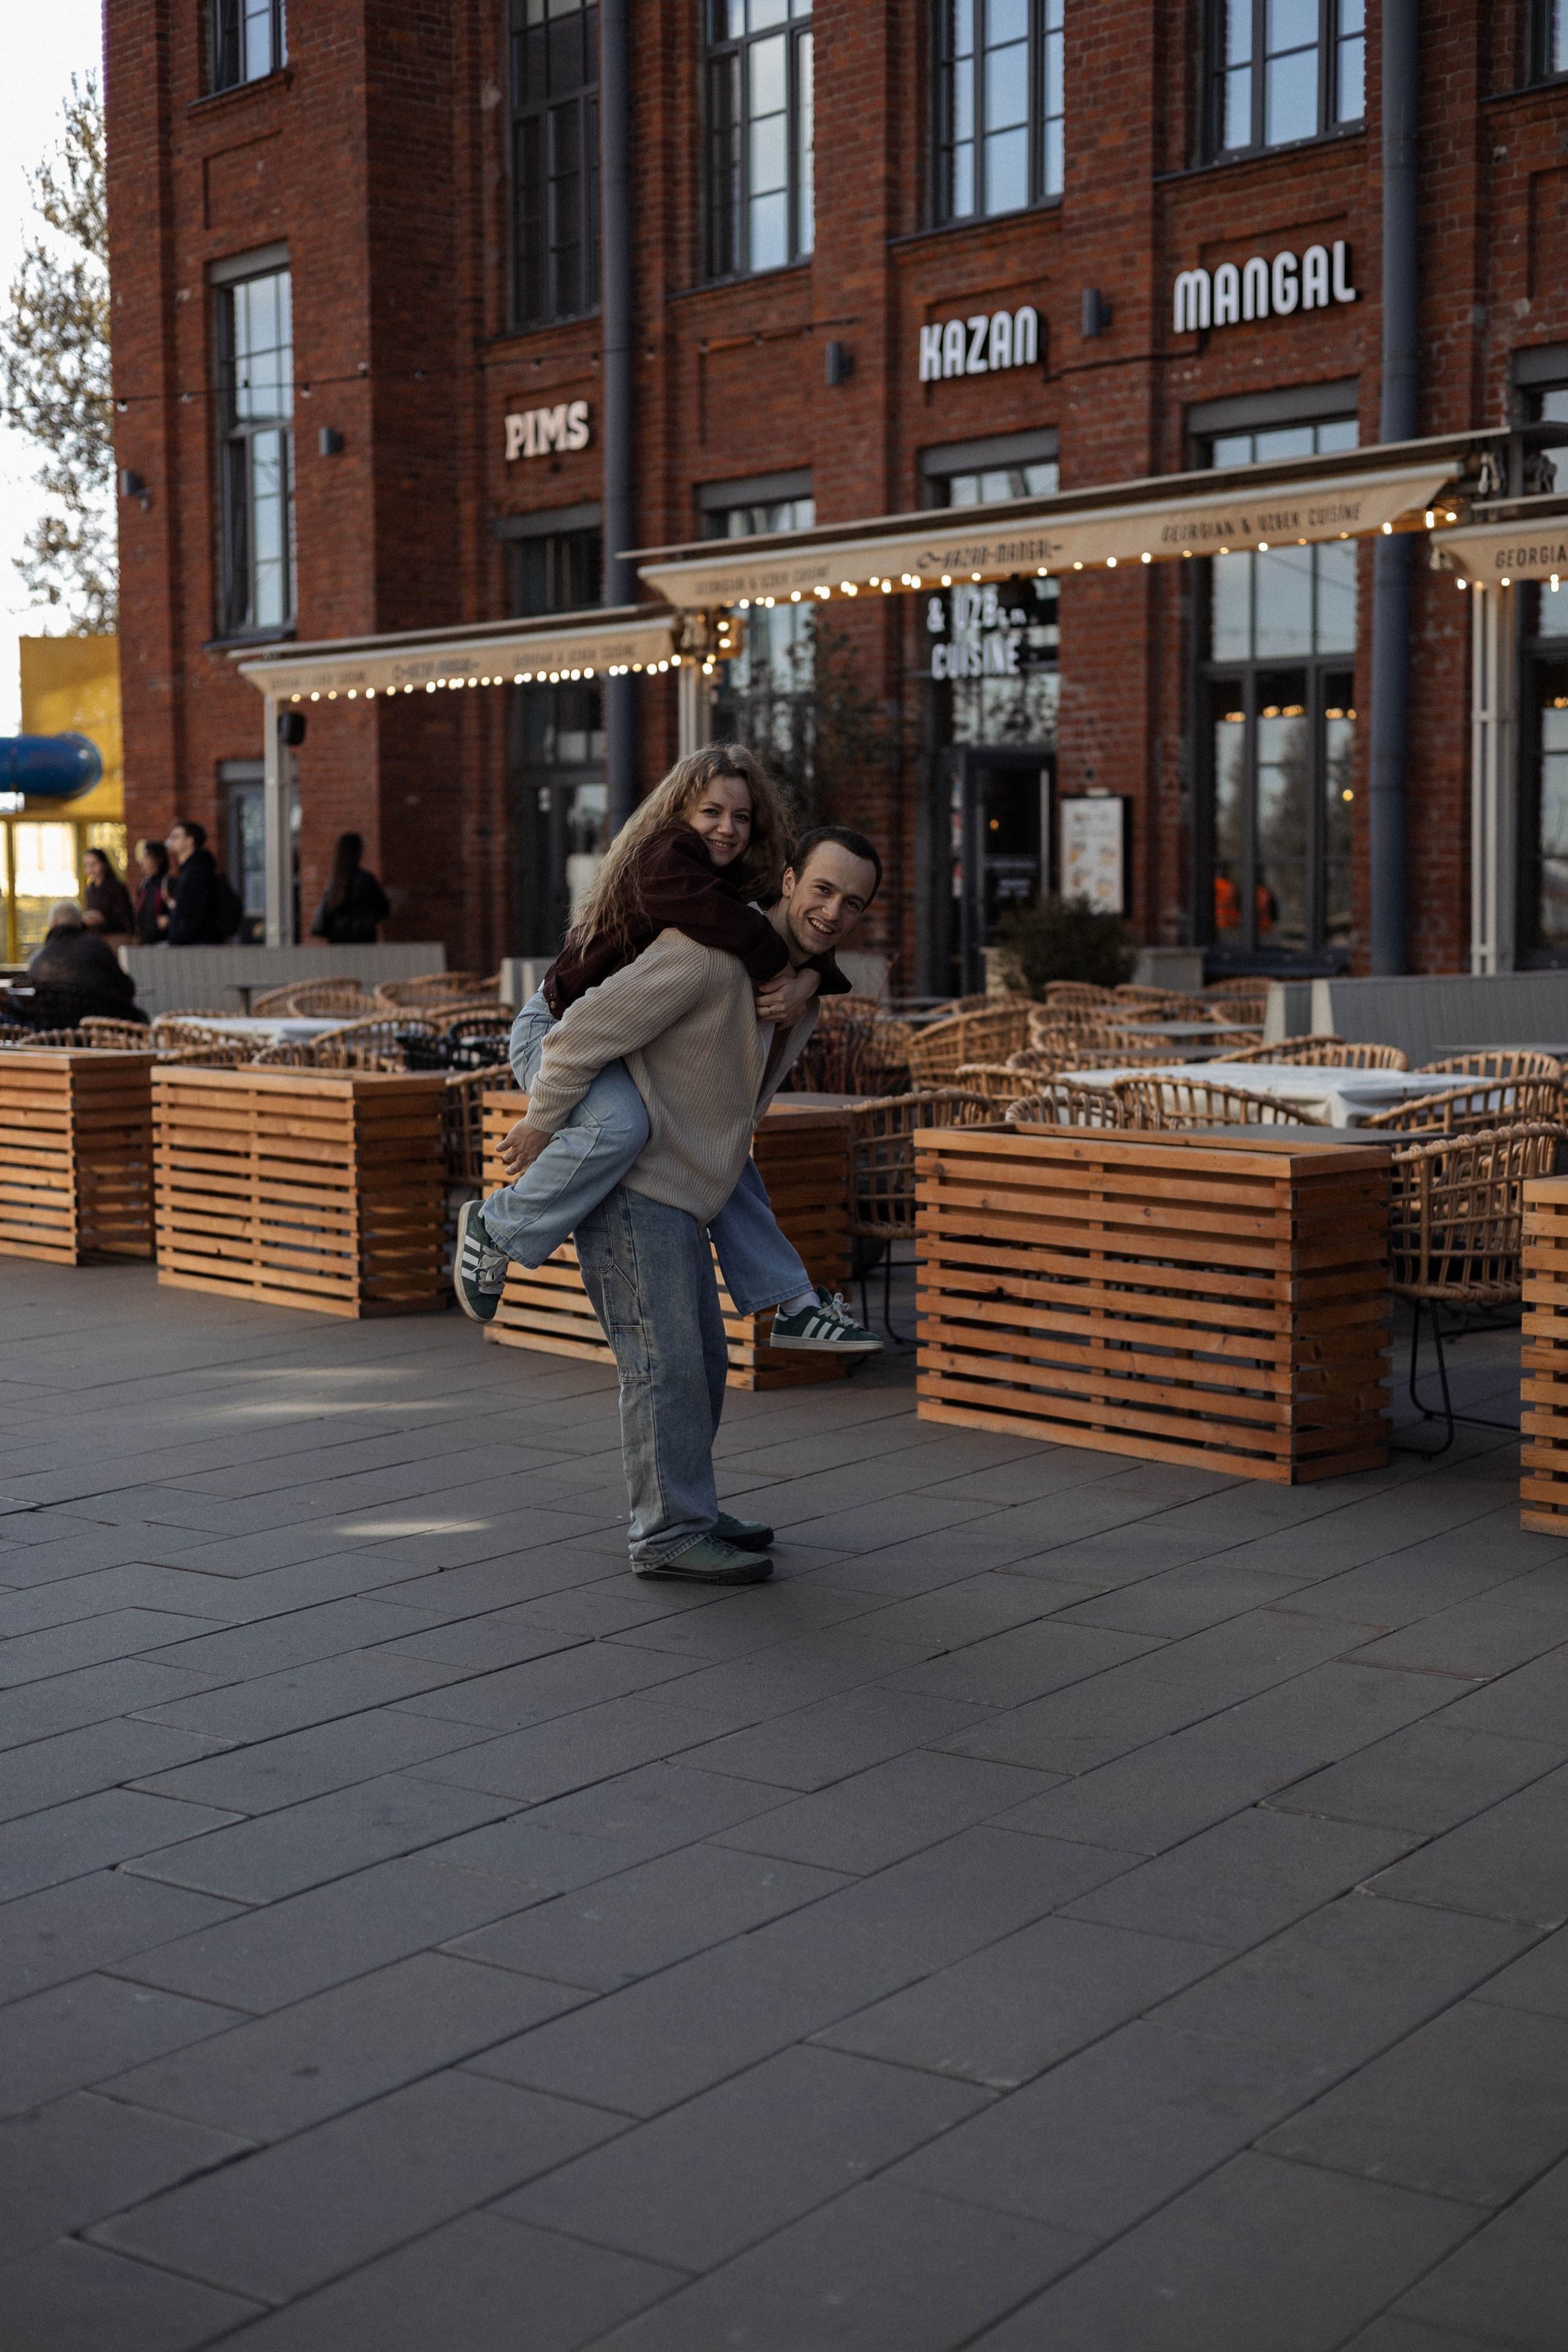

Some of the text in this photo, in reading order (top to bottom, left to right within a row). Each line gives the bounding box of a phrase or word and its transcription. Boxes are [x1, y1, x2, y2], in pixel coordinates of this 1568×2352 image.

[919, 239, 1356, 382] KAZAN MANGAL
[504, 400, 589, 461] PIMS
[1257, 511, 1300, 532] UZBEK
[1308, 502, 1360, 527] CUISINE
[927, 596, 946, 633] &
[931, 636, 1022, 681] CUISINE
